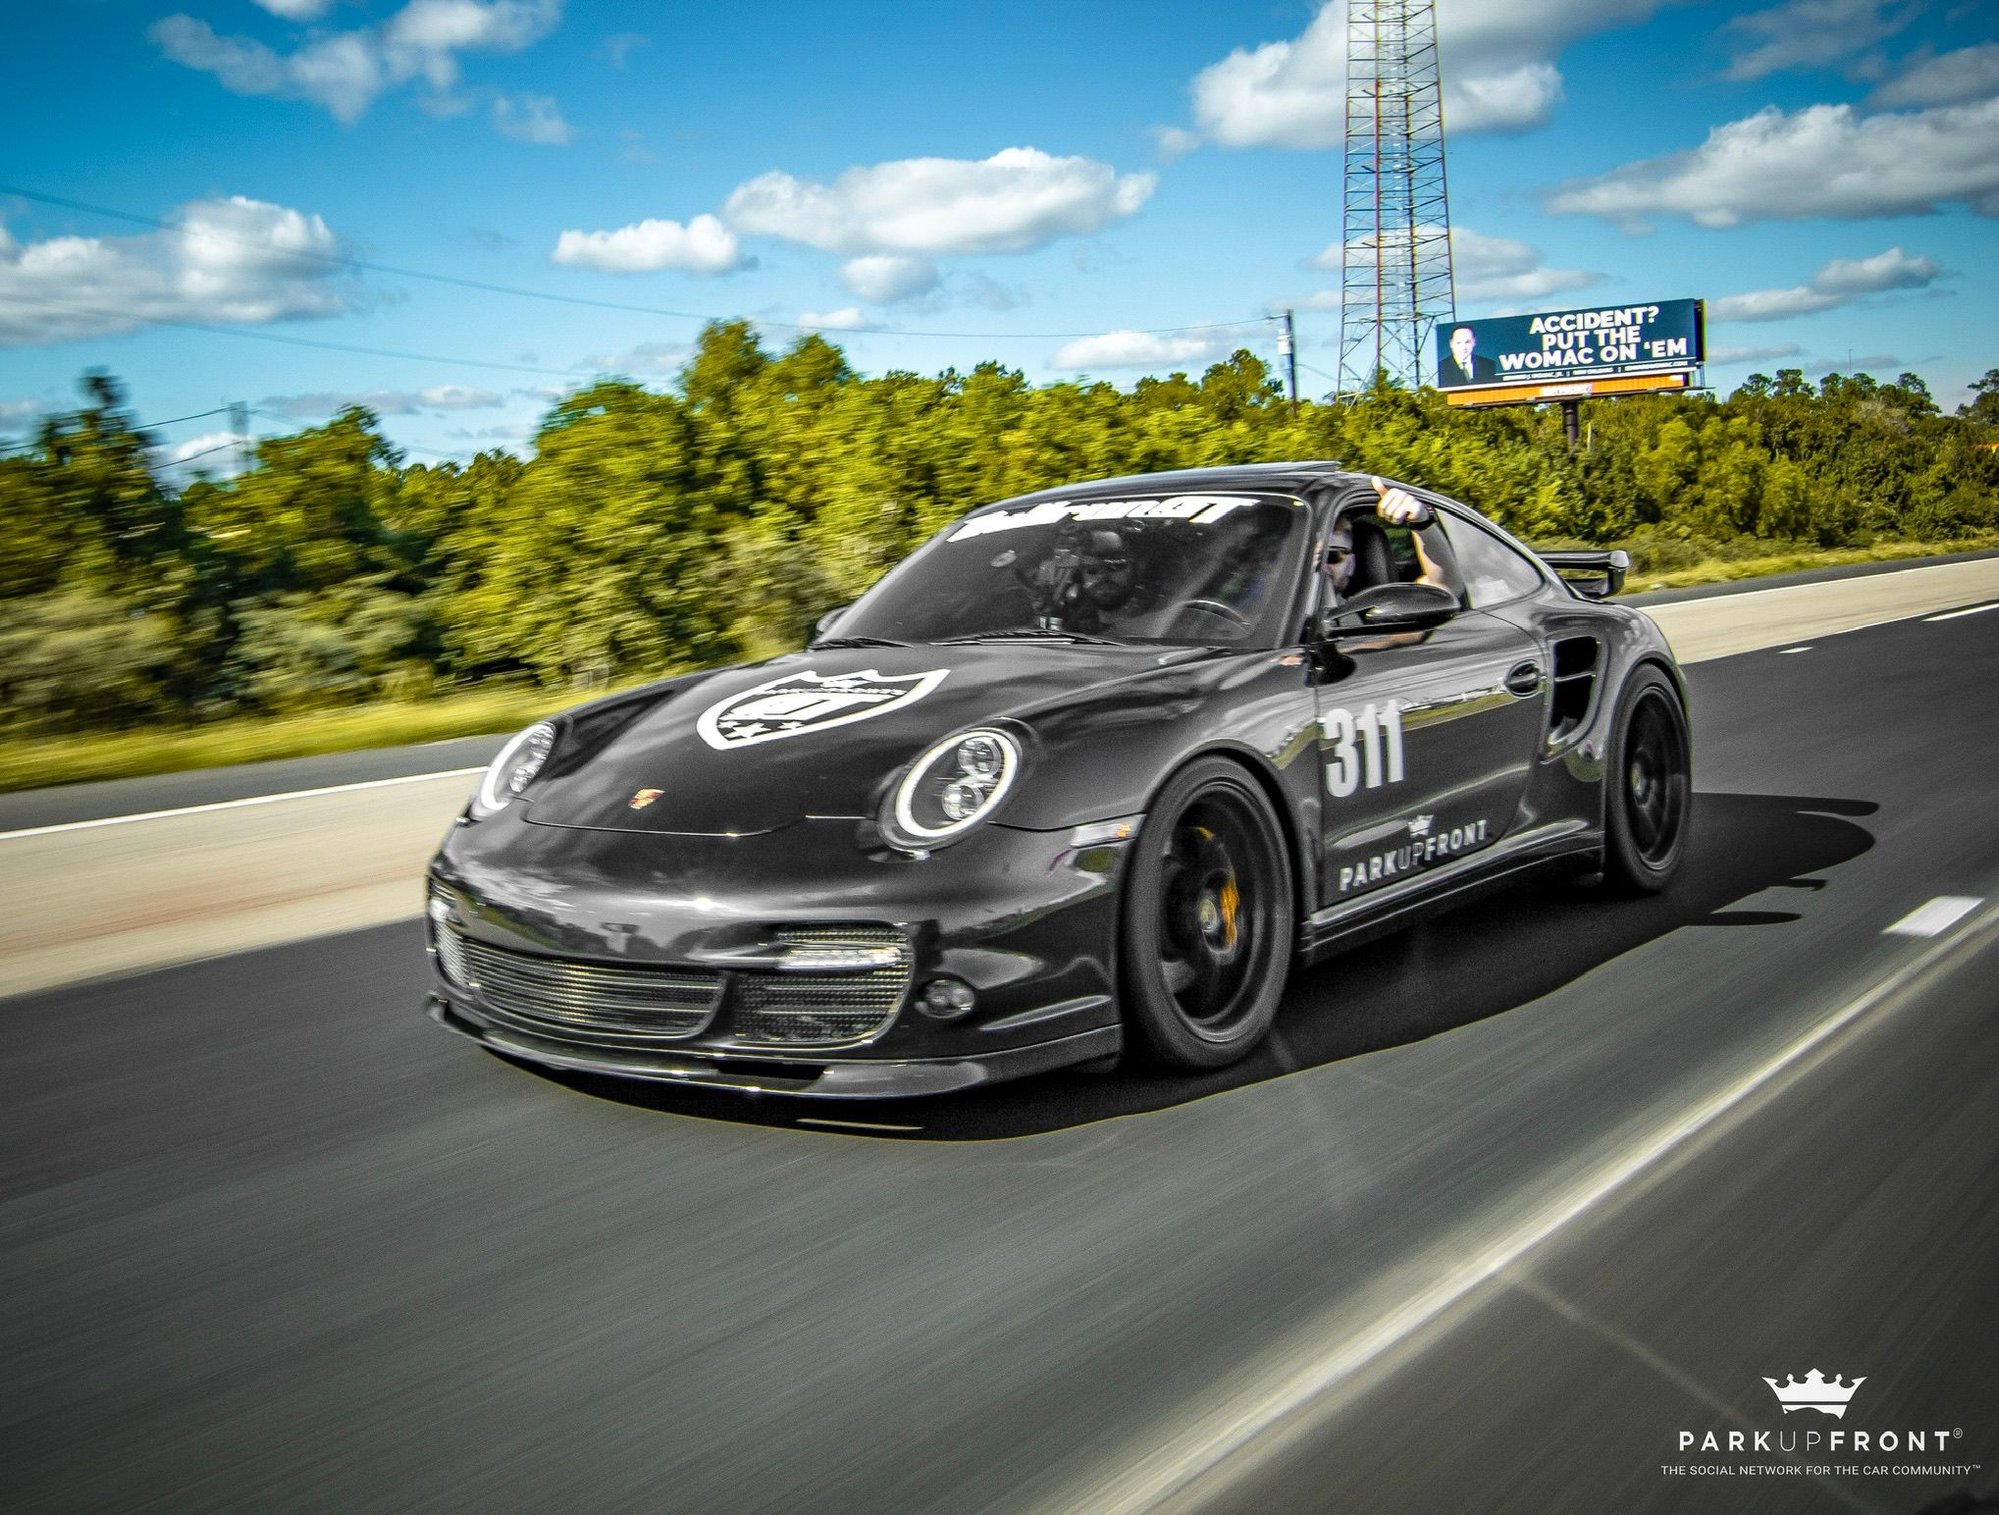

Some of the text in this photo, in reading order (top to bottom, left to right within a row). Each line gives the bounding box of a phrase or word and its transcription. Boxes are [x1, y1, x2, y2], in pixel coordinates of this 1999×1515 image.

[1529, 306, 1659, 334] ACCIDENT?
[1542, 326, 1641, 351] PUT THE
[1499, 348, 1594, 370] WOMAC
[1600, 345, 1637, 363] ON
[1323, 699, 1403, 797] 311
[1338, 819, 1488, 891] PARKUPFRONT
